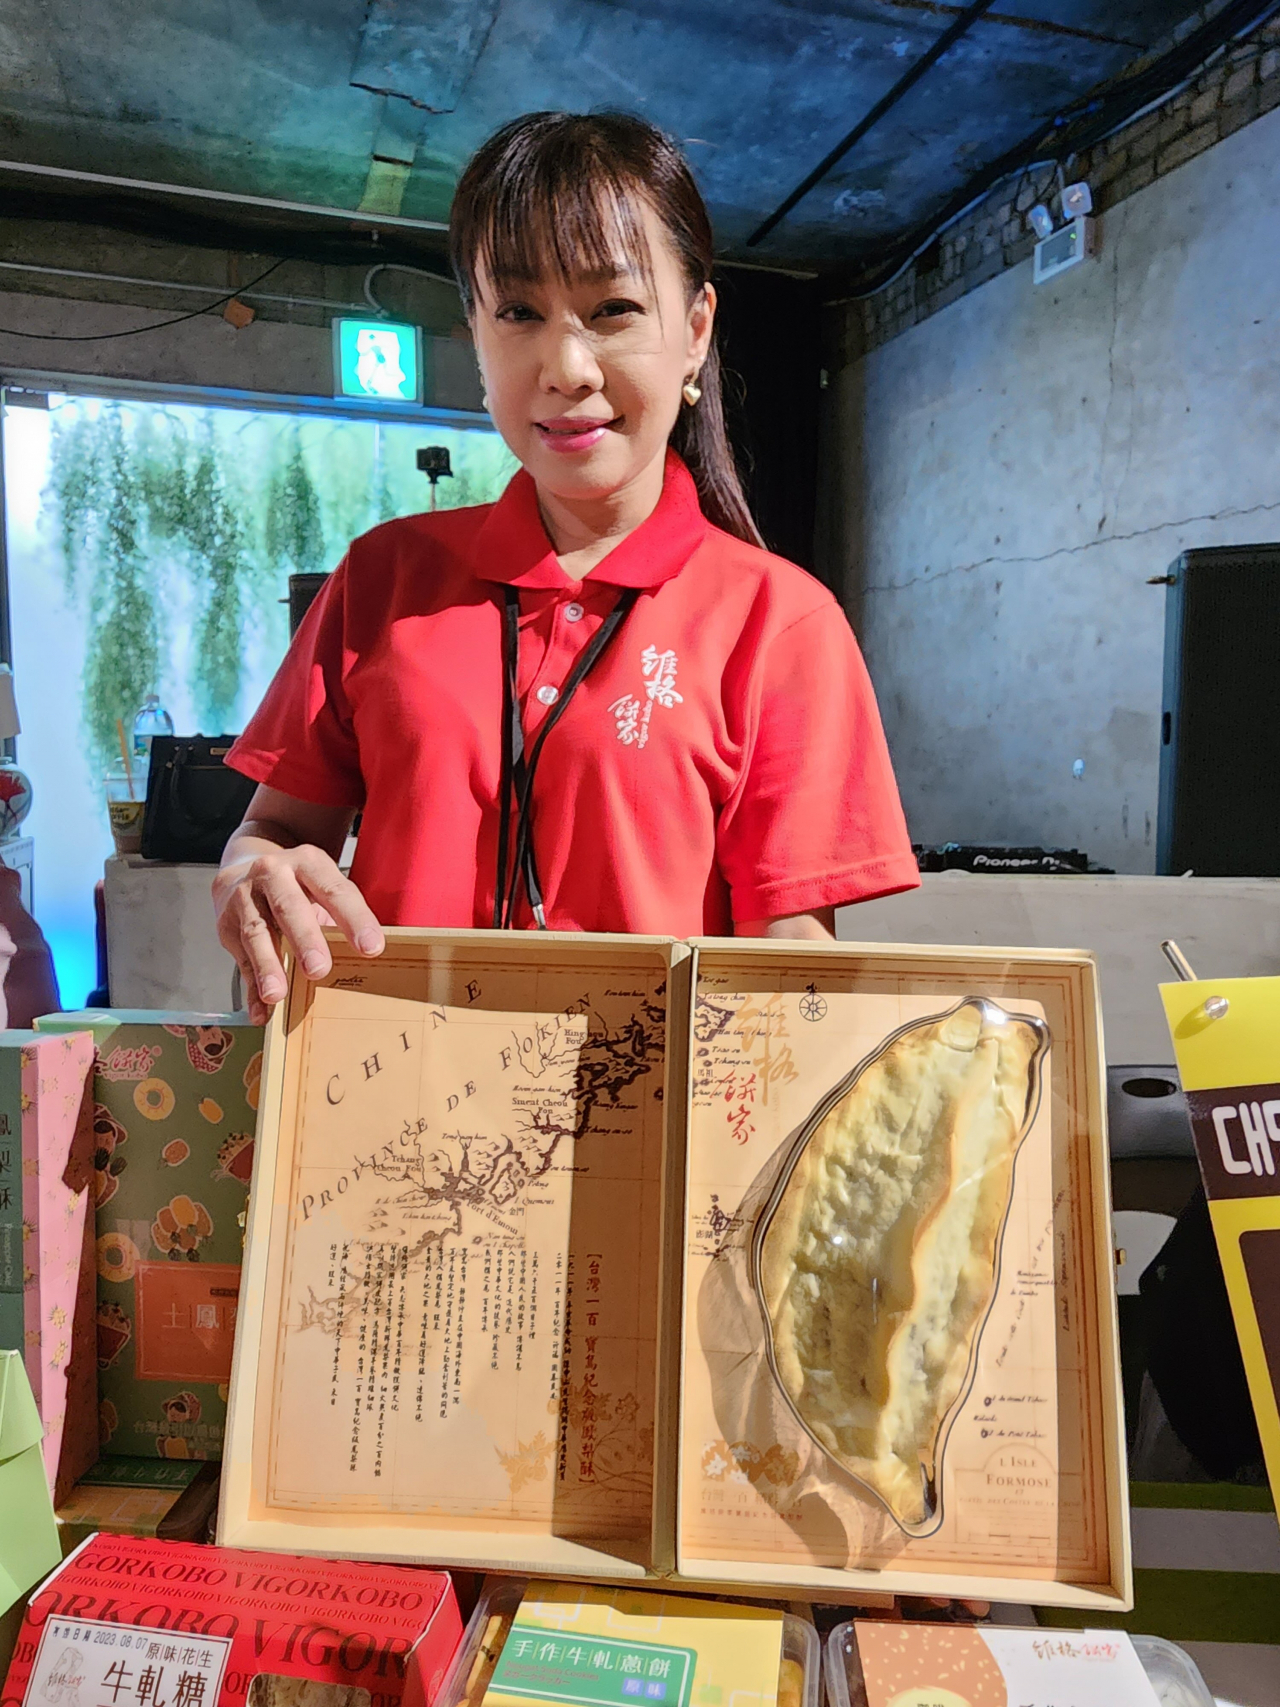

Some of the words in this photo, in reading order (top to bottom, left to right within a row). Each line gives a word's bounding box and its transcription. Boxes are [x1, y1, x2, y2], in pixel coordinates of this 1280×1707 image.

[641, 644, 684, 709] 維格
[973, 855, 1039, 867] Pioneer
[446, 1080, 477, 1113] DE
[234, 1572, 423, 1611] VIGORKOBO
[93, 1630, 149, 1650] 2023.08.07
[252, 1618, 414, 1679] VIGOR
[101, 1660, 209, 1707] 牛軋糖
